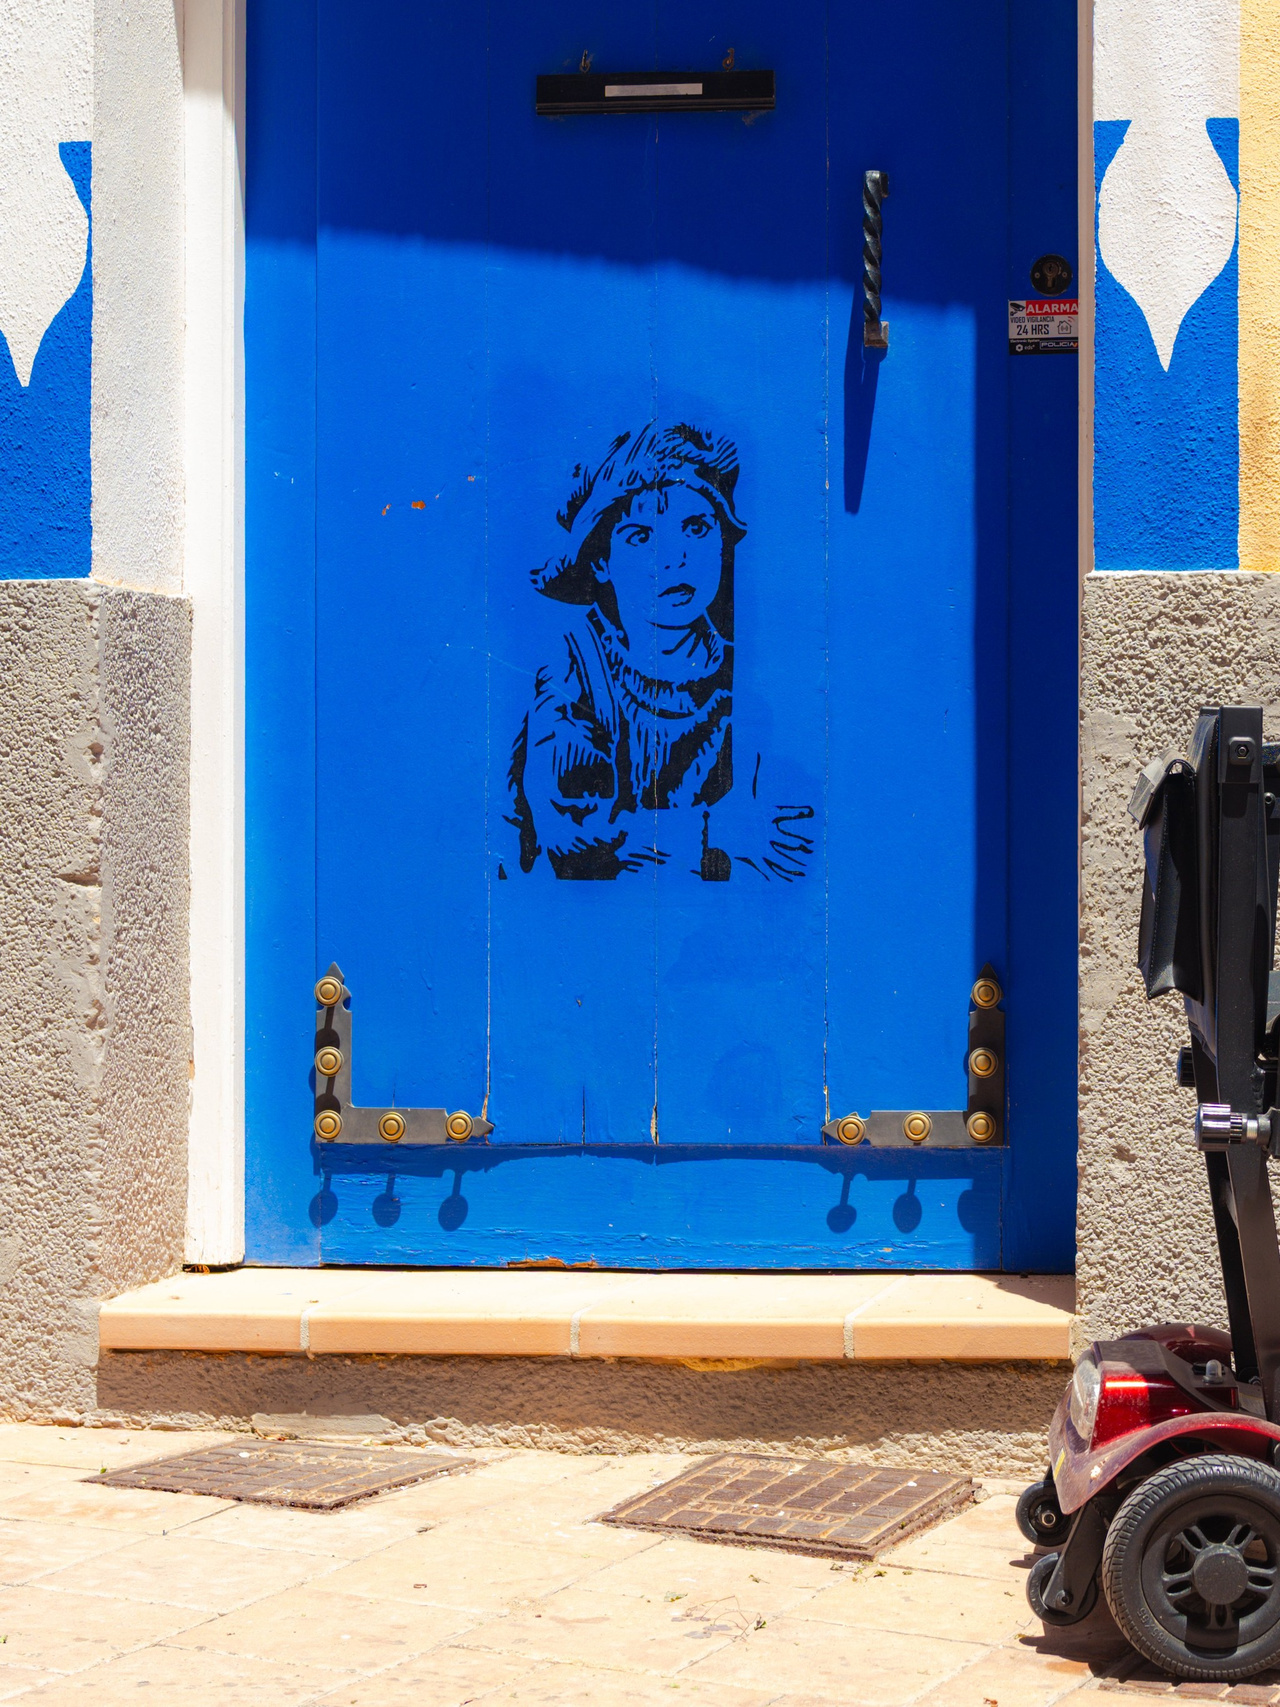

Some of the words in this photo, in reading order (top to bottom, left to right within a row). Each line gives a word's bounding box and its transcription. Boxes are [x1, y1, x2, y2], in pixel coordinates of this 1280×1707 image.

[1026, 303, 1078, 314] ALARMA
[1010, 316, 1026, 324] VIDEO
[1027, 315, 1055, 323] VIGILANCIA
[1016, 324, 1029, 336] 24
[1031, 323, 1050, 335] HRS
